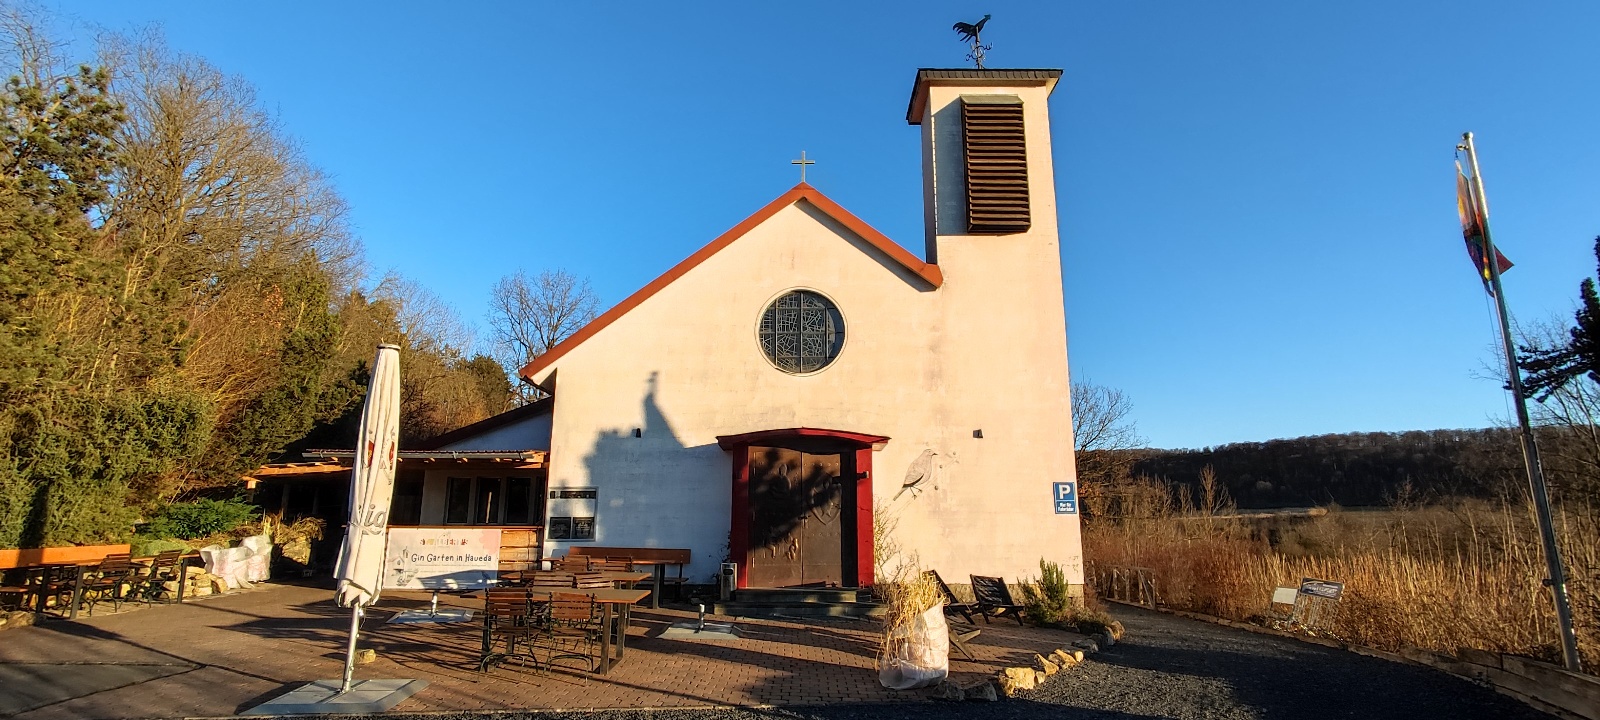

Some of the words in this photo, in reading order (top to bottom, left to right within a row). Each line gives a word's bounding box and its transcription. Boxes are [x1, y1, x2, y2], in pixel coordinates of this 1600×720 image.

[1059, 484, 1071, 499] P
[411, 553, 425, 562] Gin
[426, 553, 454, 562] Garten
[456, 554, 463, 562] in
[464, 553, 492, 562] Haueda
